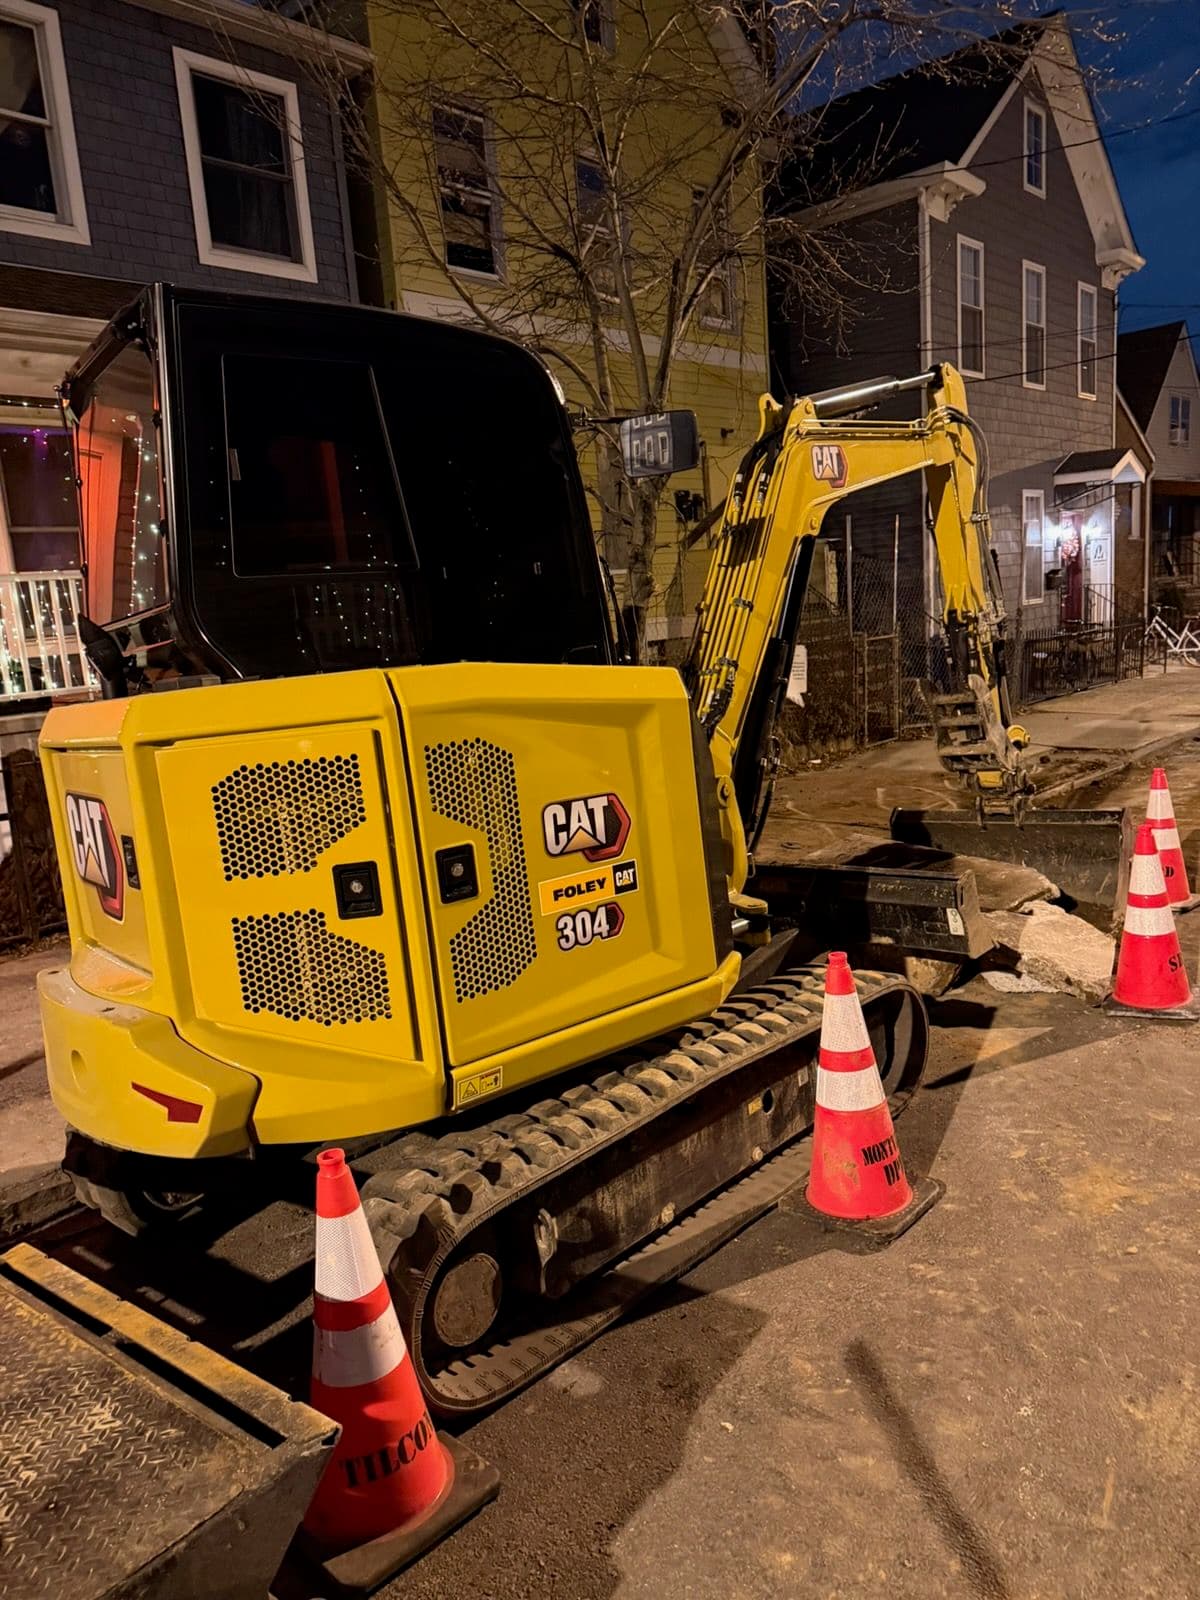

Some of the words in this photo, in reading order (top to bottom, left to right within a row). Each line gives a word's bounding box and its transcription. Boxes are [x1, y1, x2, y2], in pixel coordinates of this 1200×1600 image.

[812, 446, 839, 479] CAT
[66, 794, 111, 889] CAT
[543, 795, 608, 855] CAT
[553, 877, 607, 902] FOLEY
[615, 868, 635, 887] CAT
[557, 905, 610, 950] 304
